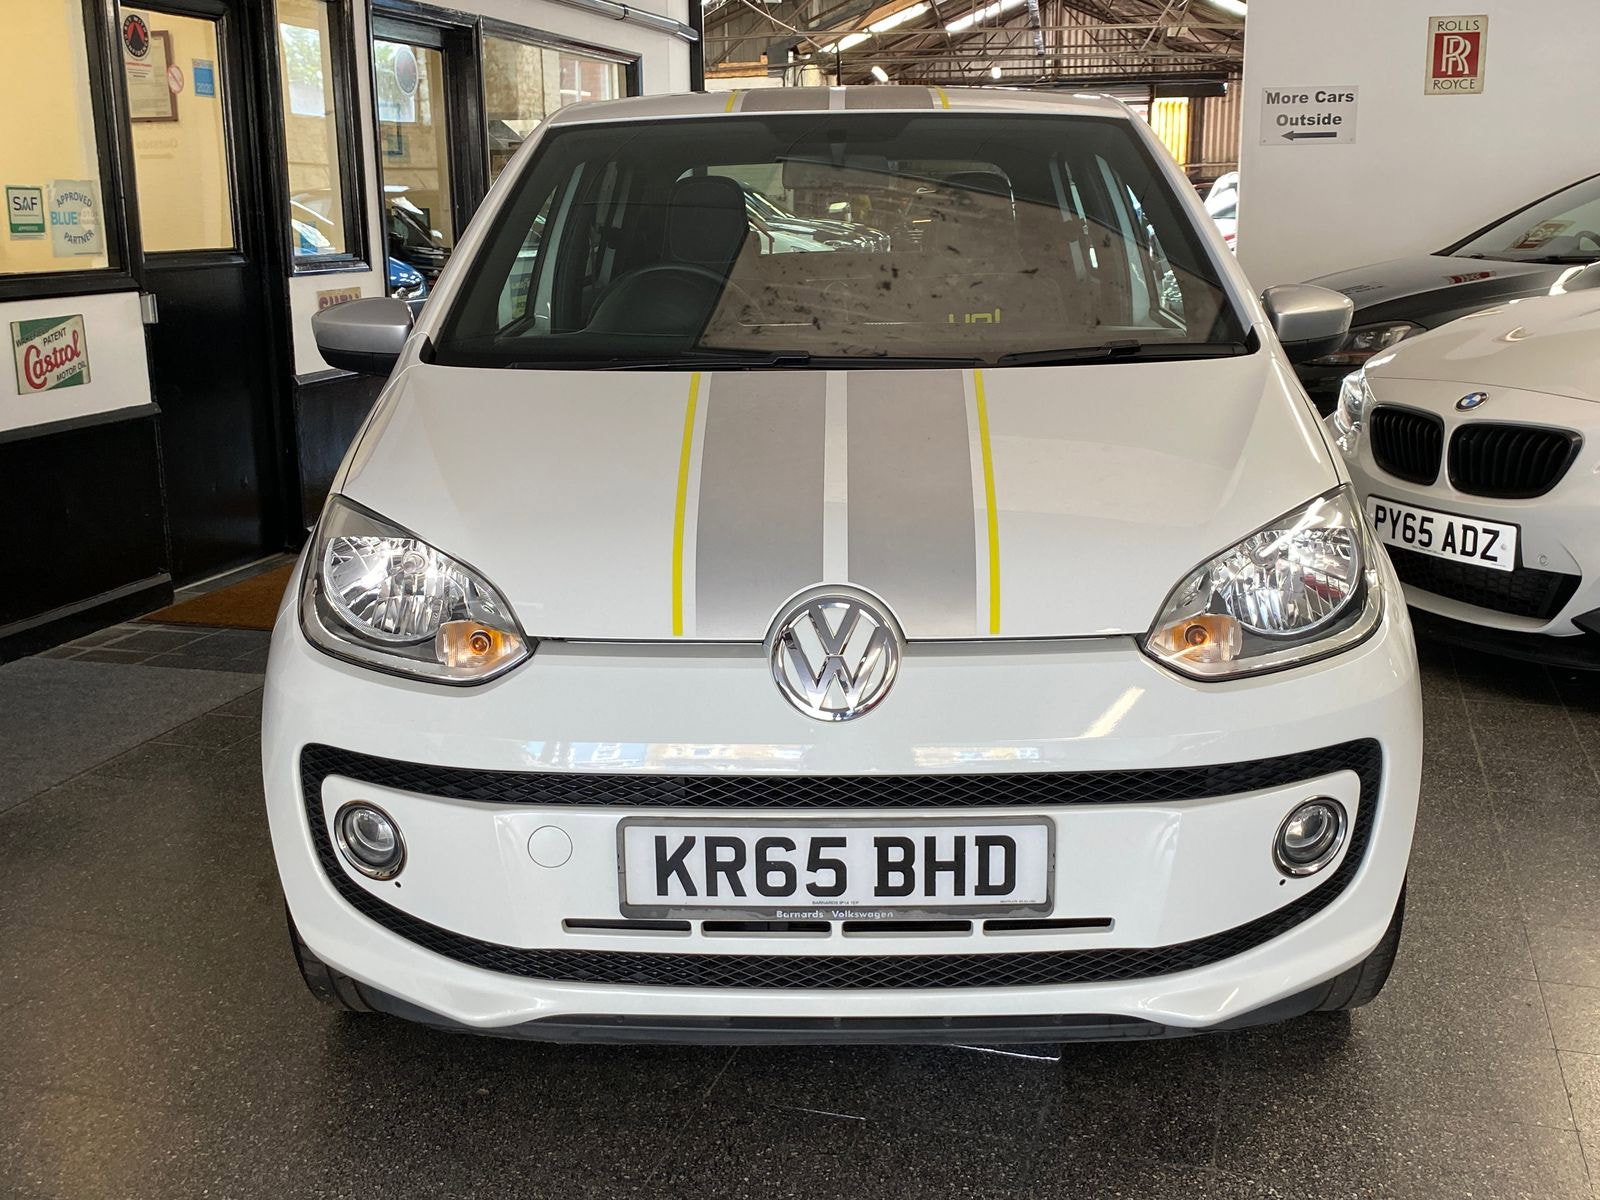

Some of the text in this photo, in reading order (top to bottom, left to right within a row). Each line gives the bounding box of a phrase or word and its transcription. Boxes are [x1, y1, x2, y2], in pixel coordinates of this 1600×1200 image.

[1437, 20, 1480, 31] ROLLS
[1433, 79, 1476, 90] ROYCE
[1266, 91, 1355, 104] More Cars
[1276, 113, 1343, 126] Outside
[12, 196, 38, 211] SAF
[56, 192, 93, 207] APPROVED
[50, 211, 78, 225] BLUE
[64, 229, 95, 244] PARTNER
[43, 327, 67, 346] PATENT
[24, 330, 81, 389] Castrol
[56, 365, 77, 381] MOTOR
[1375, 504, 1500, 562] PY65 ADZ
[654, 835, 1017, 898] KR65 BHD
[832, 910, 893, 919] Volkswagen
